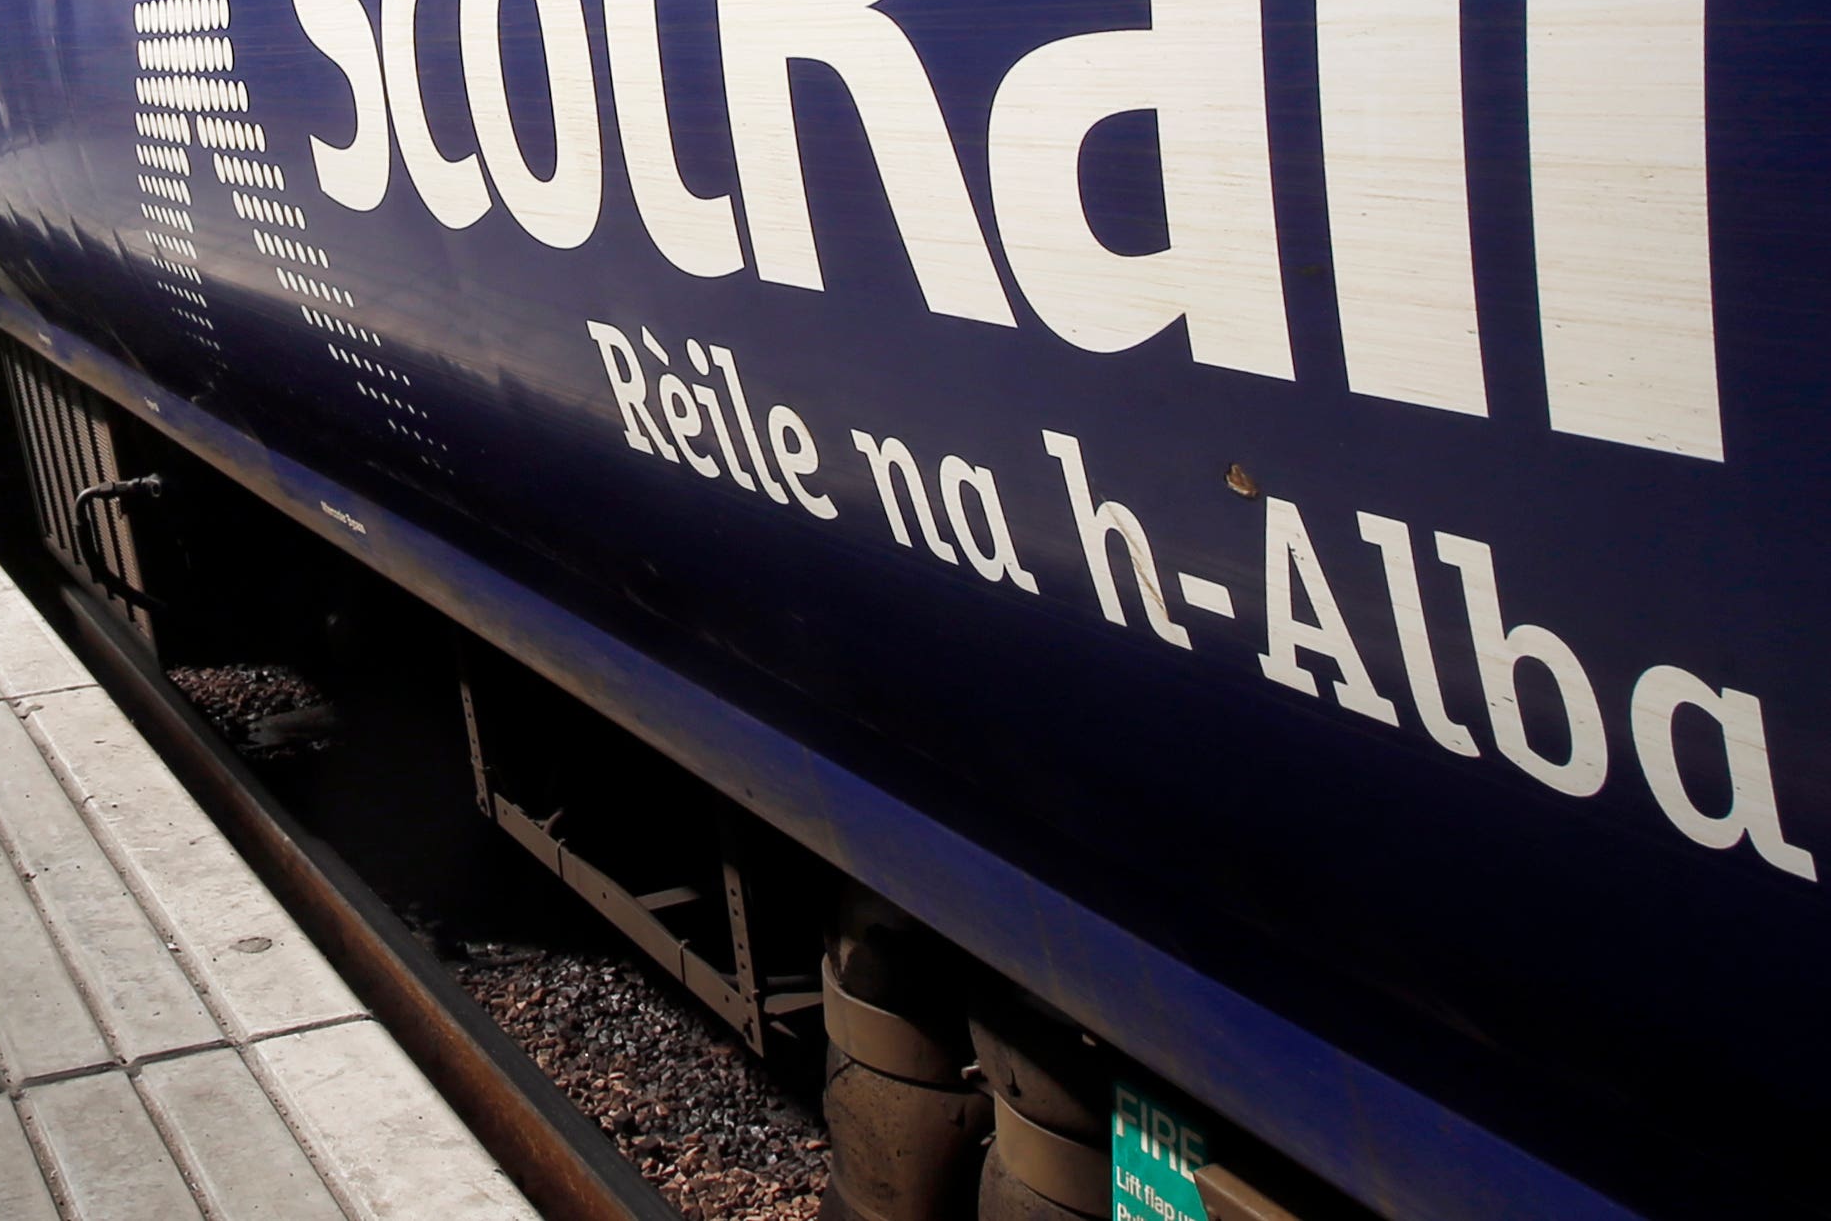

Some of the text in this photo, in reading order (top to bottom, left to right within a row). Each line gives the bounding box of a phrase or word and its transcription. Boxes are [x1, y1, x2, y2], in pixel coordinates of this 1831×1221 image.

[586, 320, 1818, 882] Rèile na h-Alba
[1116, 1087, 1204, 1184] FIRE
[1116, 1166, 1142, 1201] Lift
[1144, 1184, 1175, 1221] flap
